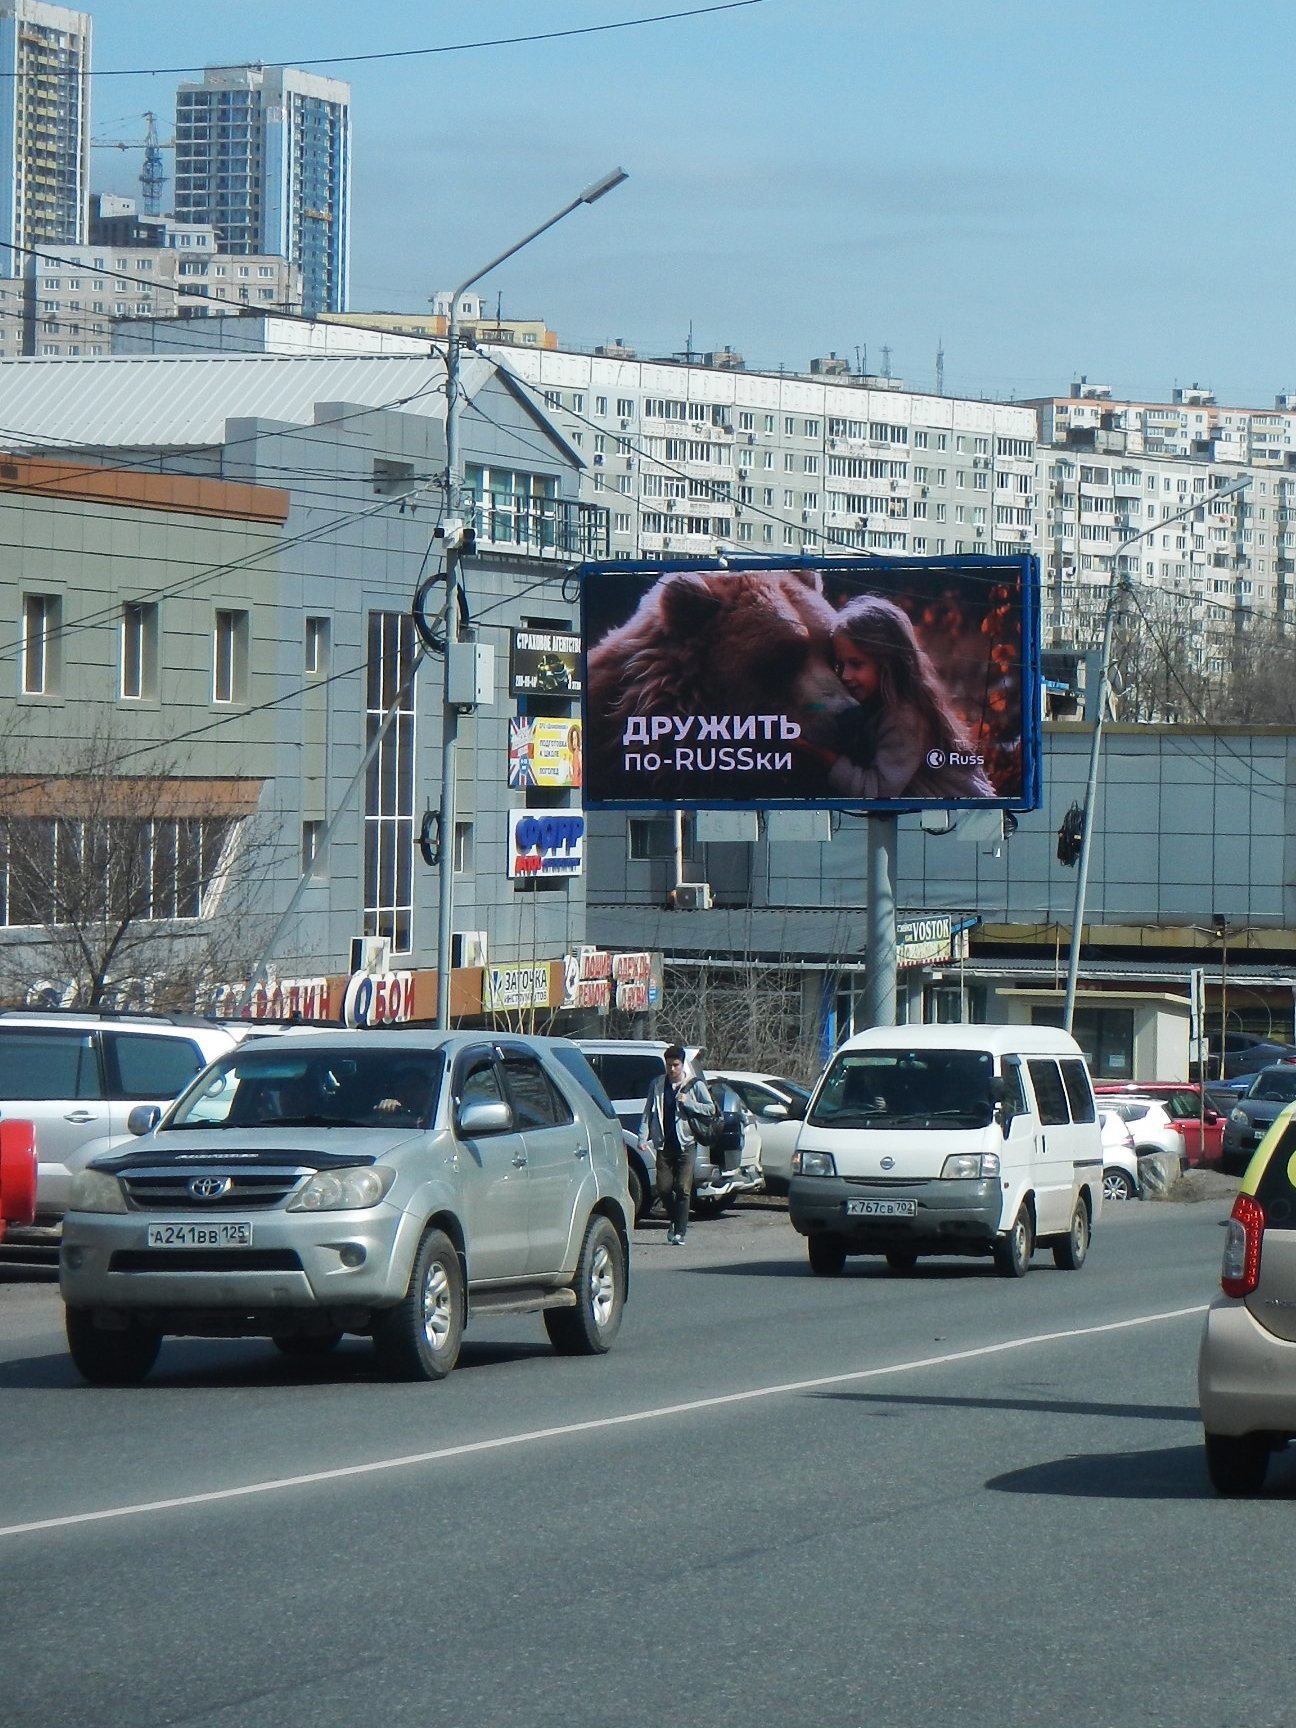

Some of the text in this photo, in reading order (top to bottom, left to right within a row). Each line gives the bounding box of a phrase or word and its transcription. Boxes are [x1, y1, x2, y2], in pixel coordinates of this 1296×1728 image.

[516, 633, 551, 651] СТРАХОВОЕ
[623, 715, 801, 745] ДРУЖИТЬ
[624, 748, 792, 772] по-RUSSки
[949, 753, 985, 766] Russ
[912, 919, 949, 941] VOSTOK
[505, 970, 547, 990] ЗАТОЧКА
[354, 974, 415, 1025] ОБОИ
[577, 981, 612, 1007] РЕМОНТ
[154, 1226, 245, 1243] А241ВВ 125
